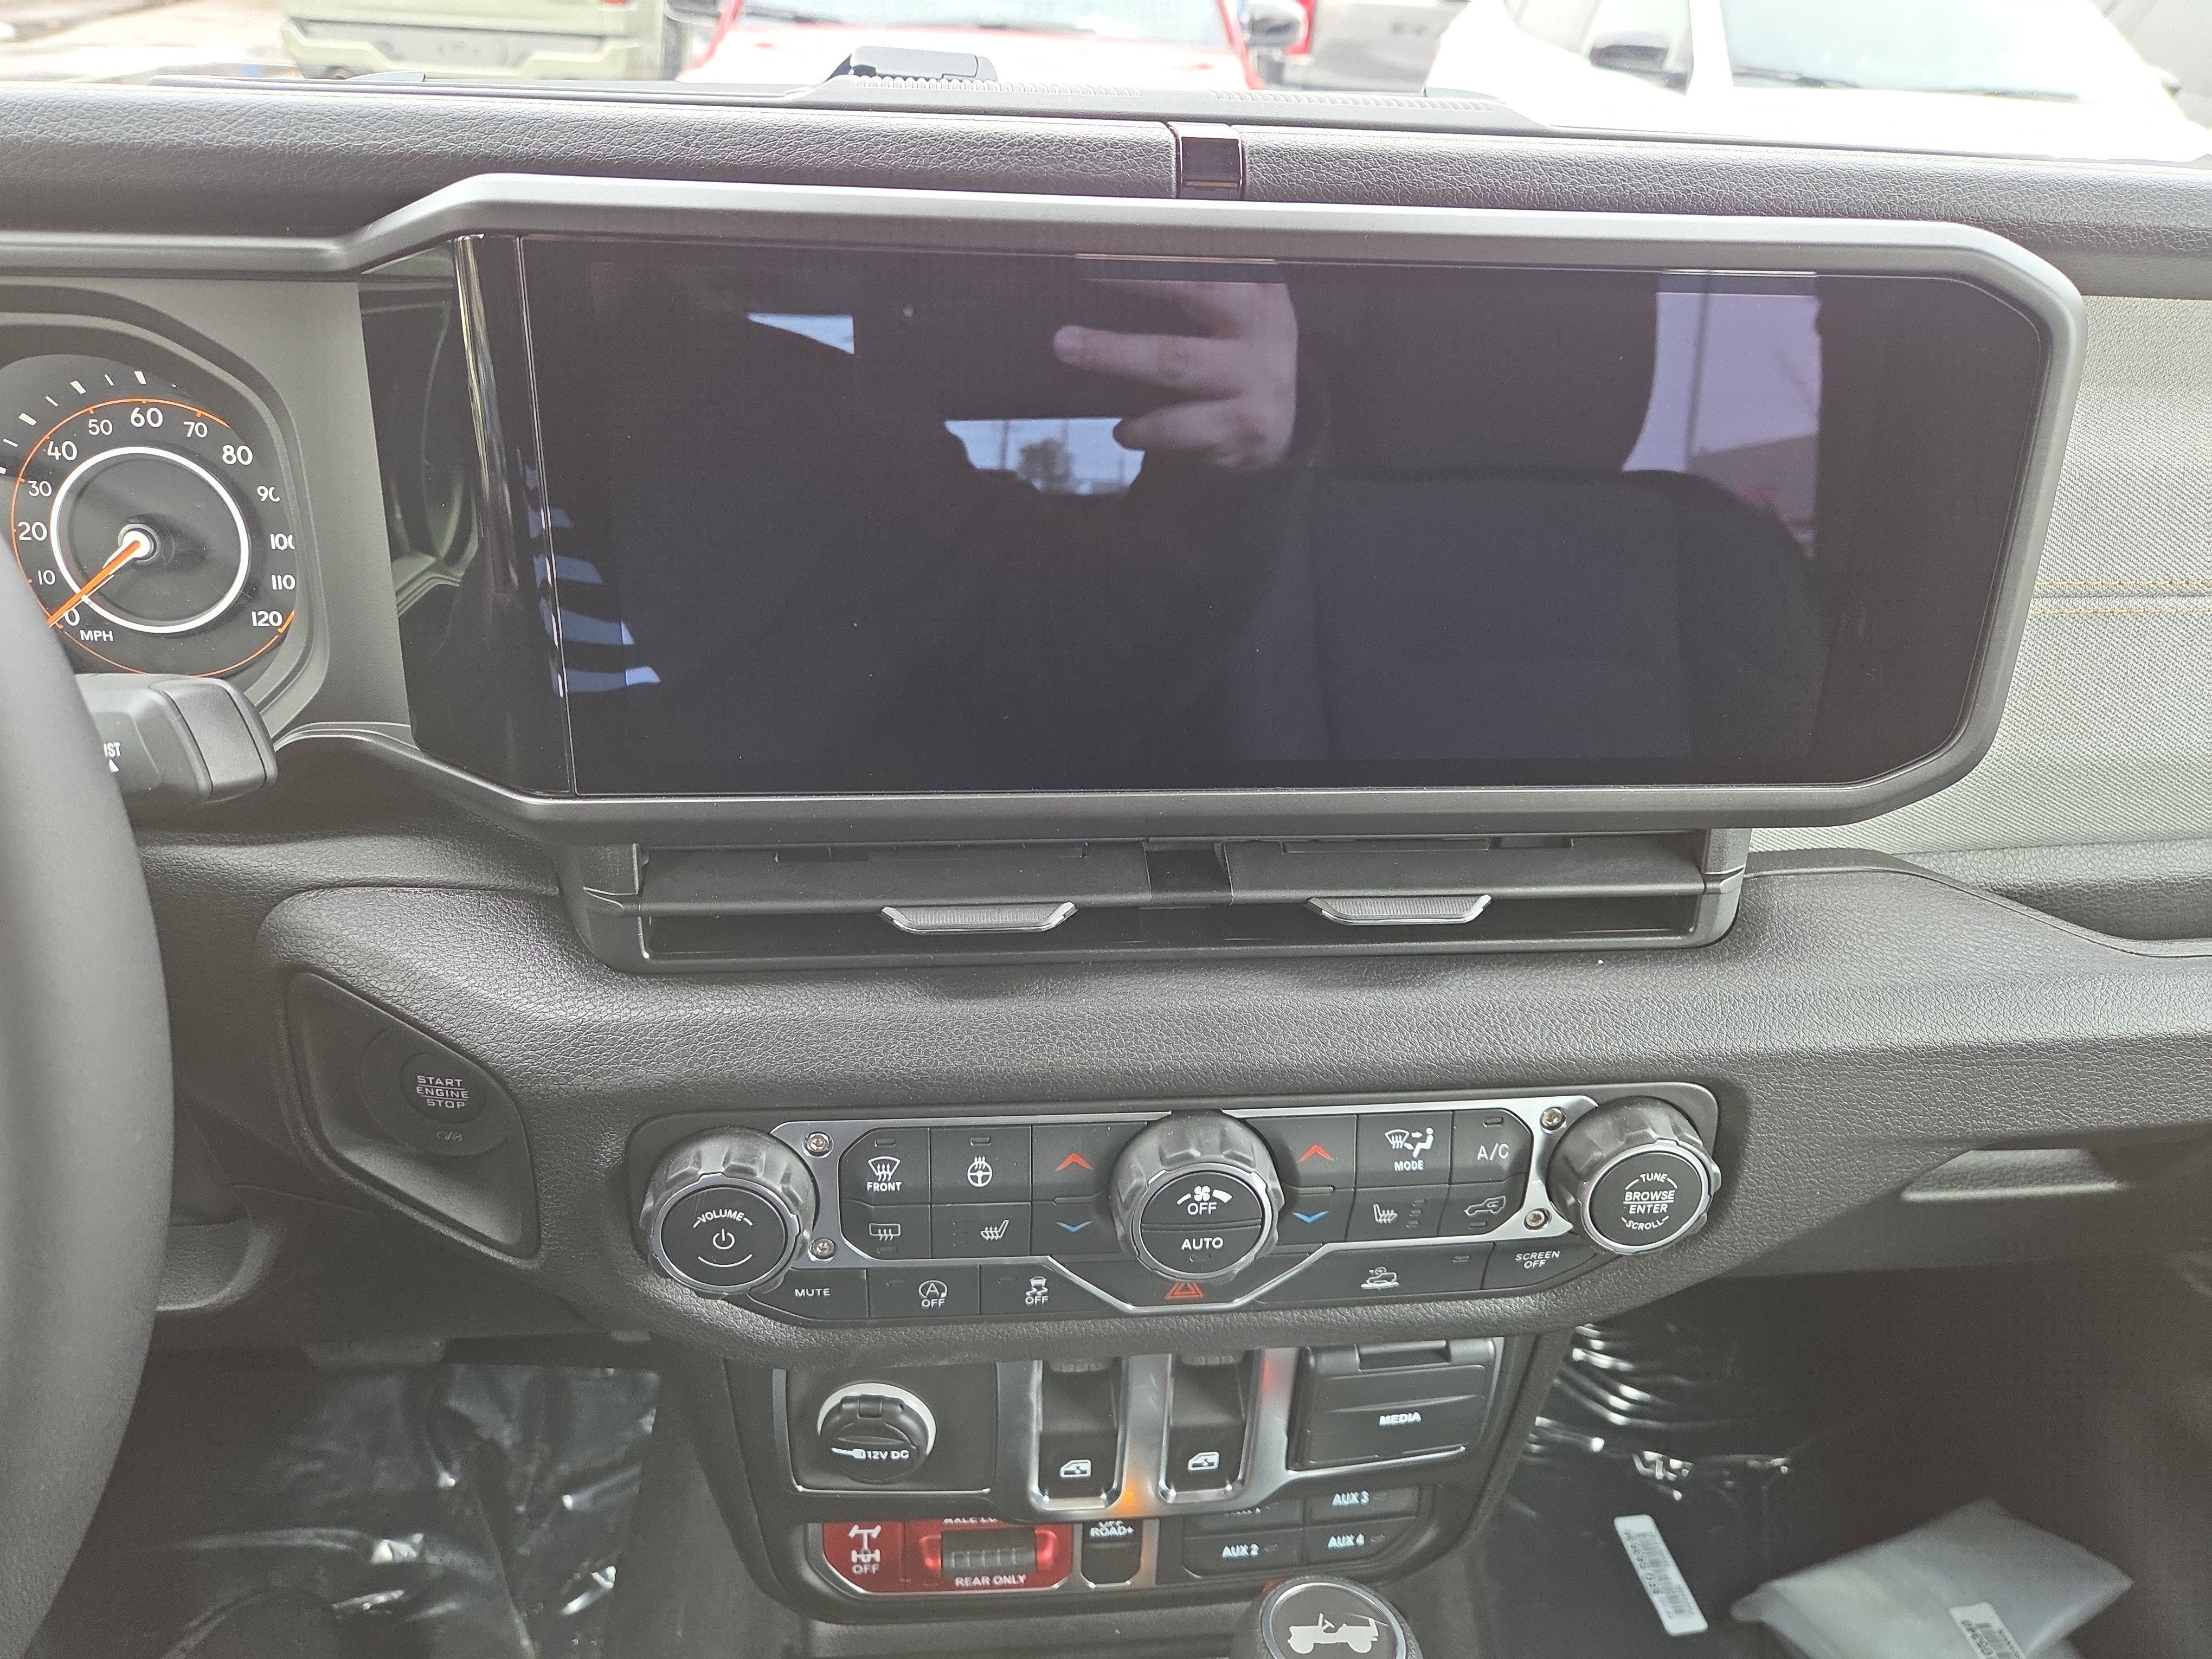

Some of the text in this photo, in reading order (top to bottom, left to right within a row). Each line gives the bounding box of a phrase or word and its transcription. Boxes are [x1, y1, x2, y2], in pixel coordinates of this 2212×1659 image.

[130, 407, 163, 428] 60
[88, 419, 113, 436] 50
[183, 421, 208, 438] 70
[47, 441, 78, 461] 40
[222, 445, 253, 465] 80
[28, 481, 52, 497] 30
[18, 522, 48, 541] 20
[38, 570, 56, 586] 10
[272, 575, 295, 590] 110
[65, 608, 80, 626] 0
[251, 611, 282, 627] 120
[80, 629, 114, 642] MPH
[103, 742, 121, 758] IST
[417, 1075, 462, 1087] START
[416, 1086, 470, 1099] ENGINE
[426, 1099, 465, 1109] STOP
[1477, 1145, 1509, 1160] A/C
[1394, 1160, 1424, 1171] MODE
[1640, 1172, 1668, 1182] TUNE
[867, 1181, 902, 1192] FRONT
[1624, 1190, 1676, 1201] BROWSE
[1187, 1202, 1217, 1215] OFF
[1629, 1204, 1668, 1214] ENTER
[698, 1210, 745, 1223] VOLUME
[1625, 1220, 1664, 1230] SCROLL
[1181, 1237, 1224, 1250] AUTO
[1515, 1251, 1560, 1262] SCREEN
[1523, 1259, 1547, 1268] OFF
[794, 1288, 831, 1297] MUTE
[922, 1298, 945, 1308] OFF
[1025, 1295, 1049, 1306] OFF
[1379, 1412, 1422, 1426] MEDIA
[866, 1450, 910, 1459] 12V DC
[1333, 1490, 1369, 1506] AUX 3
[1090, 1526, 1134, 1536] ROAD+
[1328, 1534, 1355, 1549] AUX
[1222, 1544, 1259, 1559] AUX 2
[955, 1573, 1026, 1587] REAR ONLY
